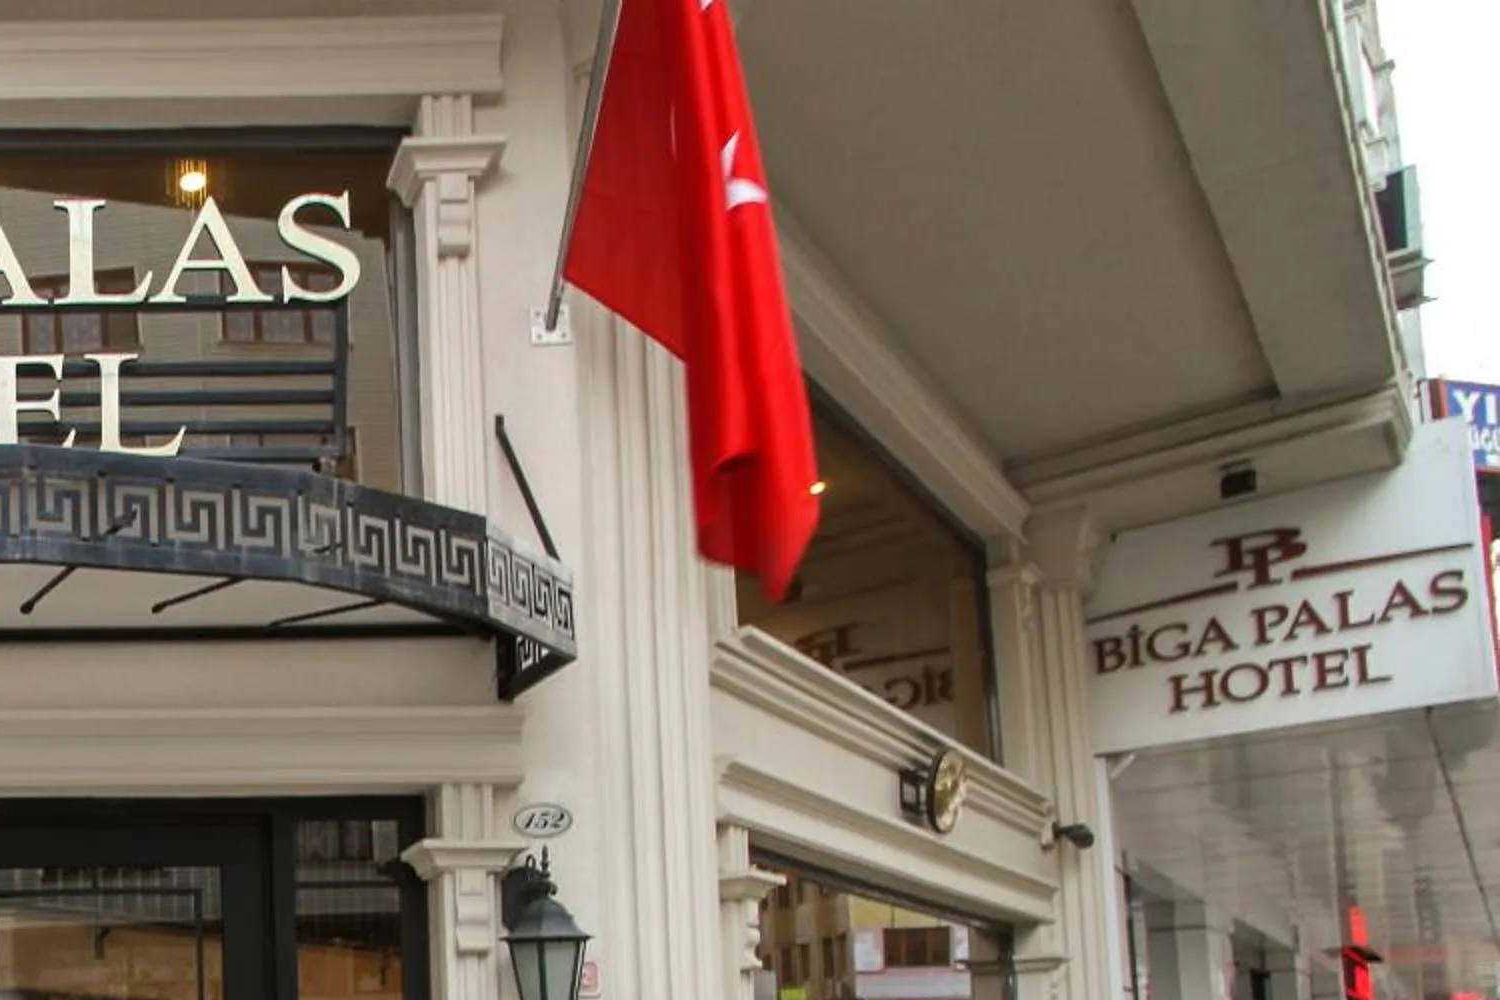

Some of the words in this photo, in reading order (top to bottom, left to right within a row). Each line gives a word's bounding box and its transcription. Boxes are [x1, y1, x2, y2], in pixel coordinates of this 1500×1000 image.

[1093, 616, 1240, 675] BİGA
[1251, 569, 1470, 648] PALAS
[1166, 644, 1394, 715] HOTEL
[524, 812, 565, 829] 152
